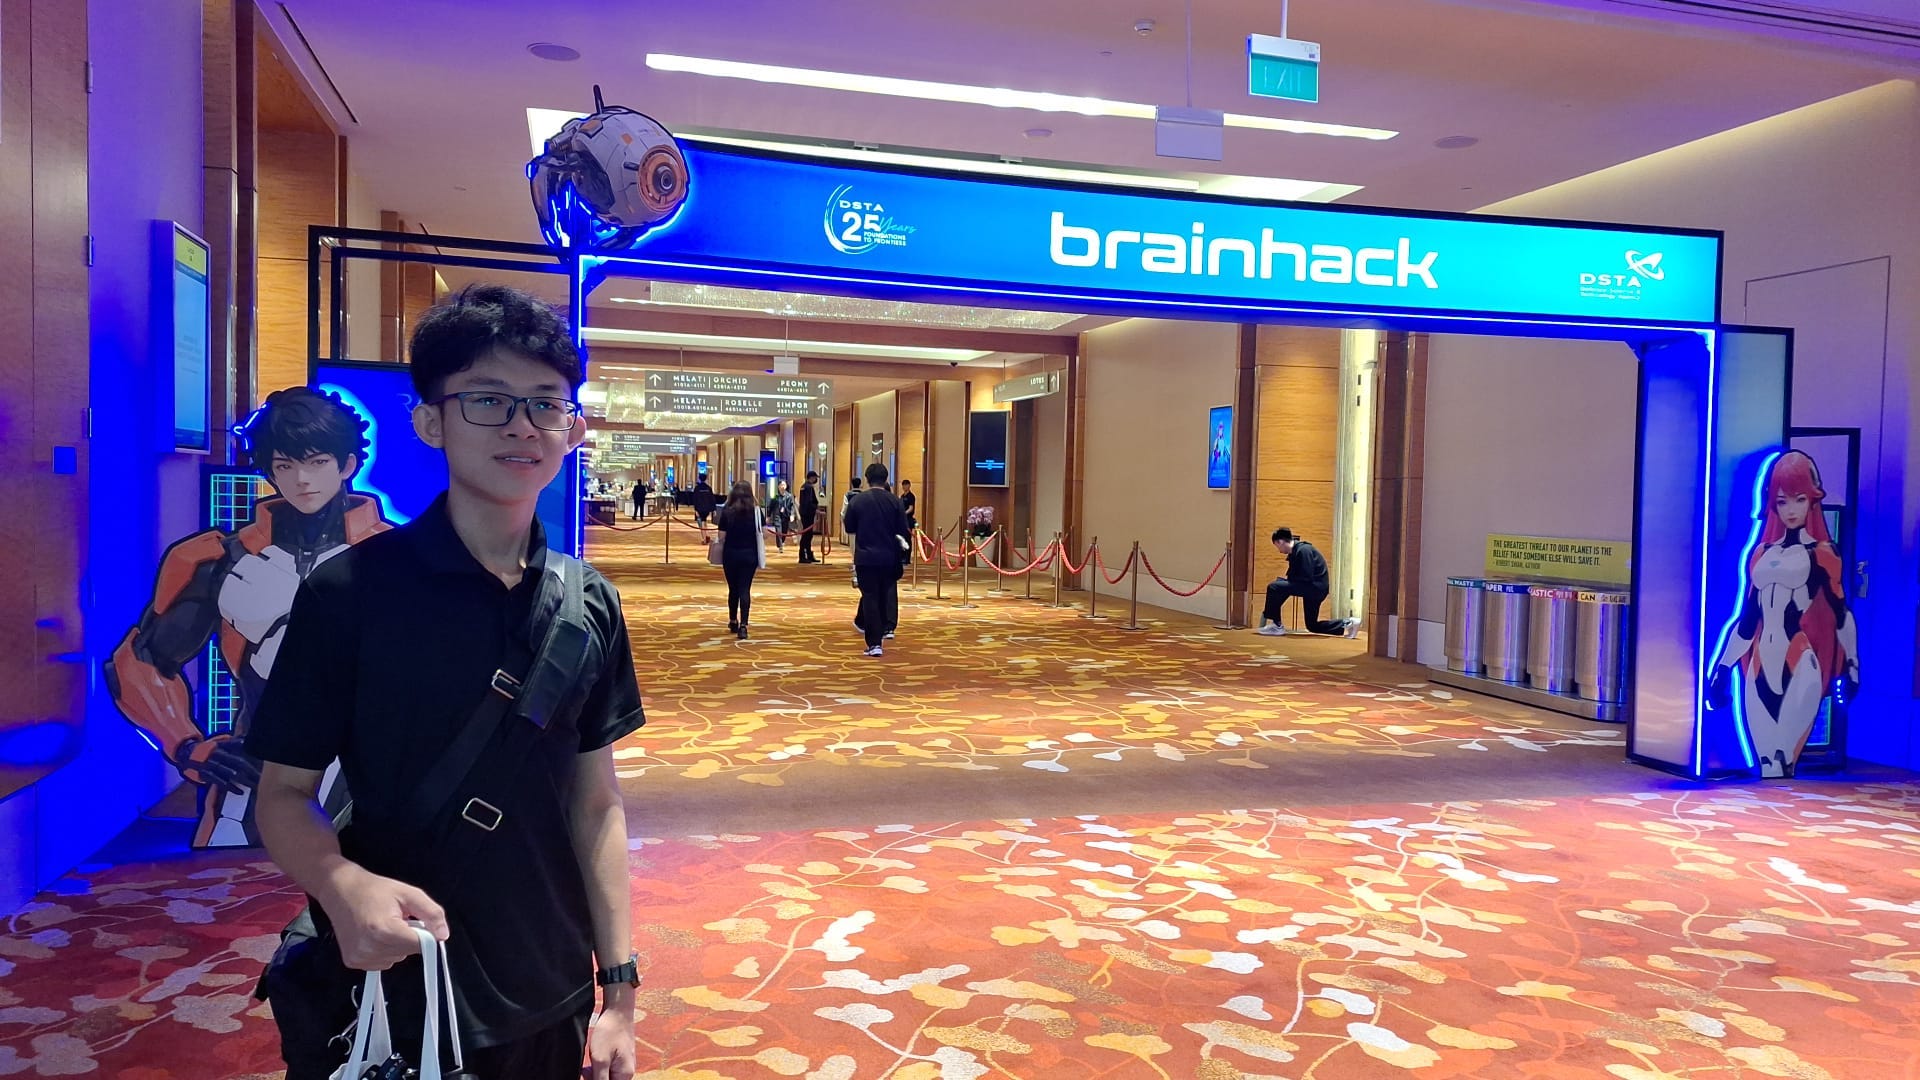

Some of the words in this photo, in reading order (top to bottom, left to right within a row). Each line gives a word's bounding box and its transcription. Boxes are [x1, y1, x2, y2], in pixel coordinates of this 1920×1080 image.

[839, 200, 884, 212] DSTA
[841, 211, 881, 242] 25
[880, 216, 918, 234] Years
[863, 231, 906, 241] FOUNDATIONS
[874, 238, 907, 246] FRONTIERS
[1049, 211, 1439, 289] brainhack
[1580, 272, 1642, 288] DSTA
[713, 376, 748, 385] ORCHID
[780, 380, 809, 388] PEONY
[776, 401, 808, 409] SIMPOR
[1504, 540, 1529, 550] GREATEST
[1529, 542, 1550, 551] THREAT
[1550, 544, 1557, 552] TO
[1558, 544, 1570, 553] OUR
[1570, 545, 1592, 554] PLANET
[1594, 546, 1600, 555] IS
[1601, 547, 1612, 556] THE
[1493, 550, 1510, 558] BELIEF
[1510, 550, 1523, 560] THAT
[1524, 552, 1548, 562] SOMEONE
[1548, 554, 1561, 562] ELSE
[1562, 555, 1577, 564] WILL
[1578, 556, 1592, 566] SAVE
